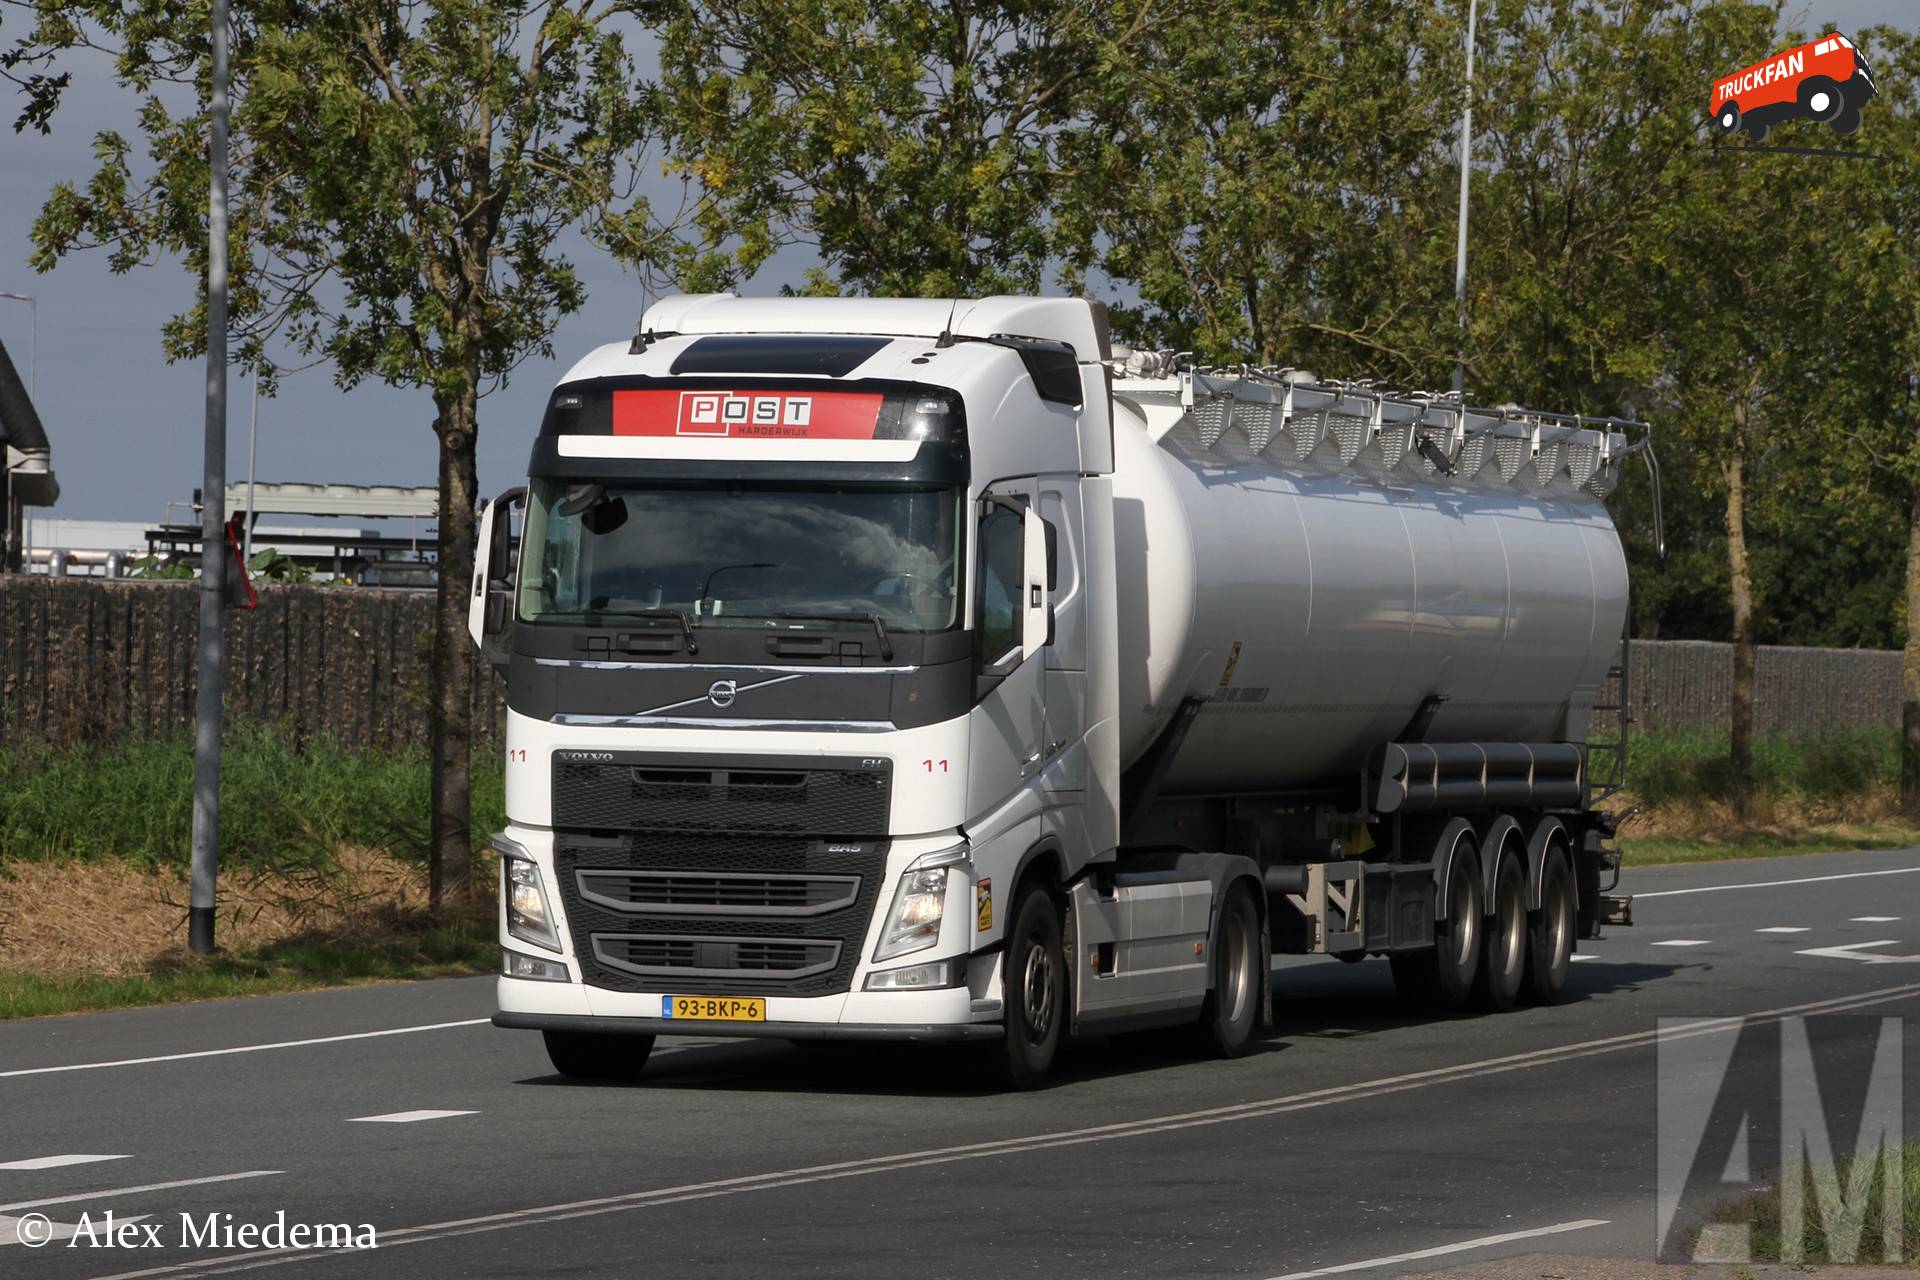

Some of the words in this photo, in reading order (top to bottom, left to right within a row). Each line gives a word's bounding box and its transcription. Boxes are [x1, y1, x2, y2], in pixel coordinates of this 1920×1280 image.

[693, 398, 811, 423] POST
[738, 426, 808, 436] HARDERWIJK
[510, 749, 527, 762] 11
[559, 751, 613, 761] VOLVO
[922, 759, 949, 773] 11
[678, 1000, 758, 1017] 93-BKP-6
